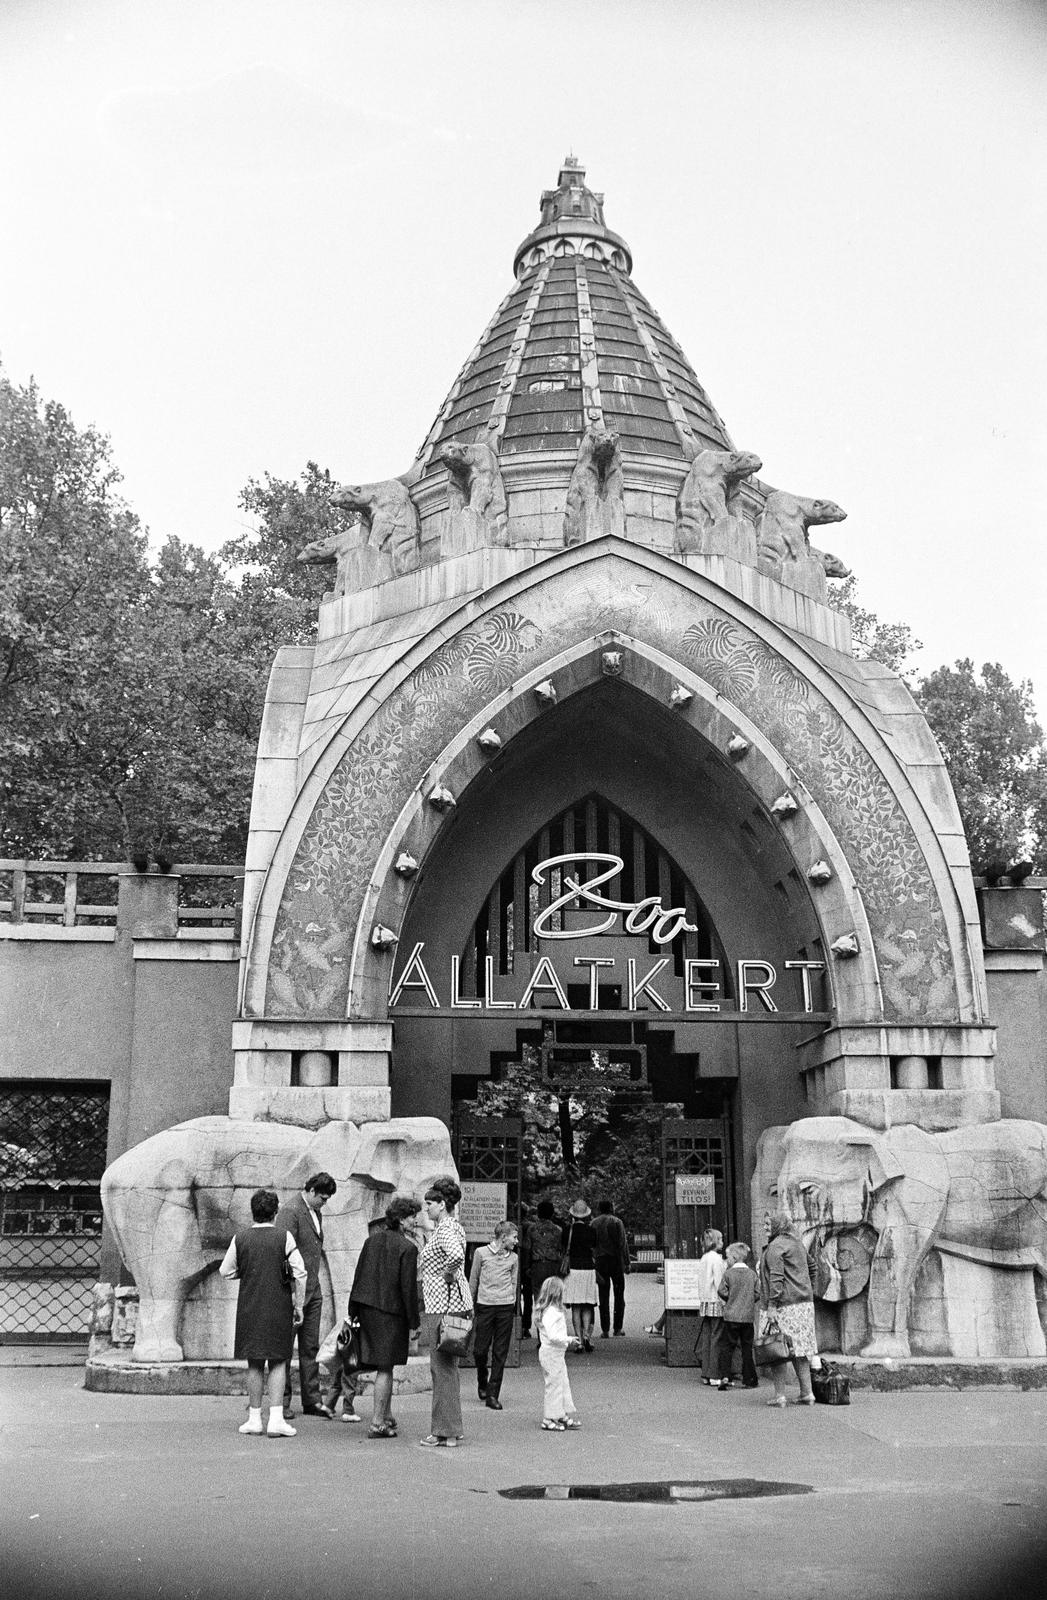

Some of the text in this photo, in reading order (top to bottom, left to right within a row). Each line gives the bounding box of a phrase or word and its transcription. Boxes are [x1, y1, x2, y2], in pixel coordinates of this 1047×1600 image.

[531, 852, 699, 945] Zoo
[388, 941, 826, 1013] ÁLLATKERT
[681, 1195, 711, 1203] TILOS!
